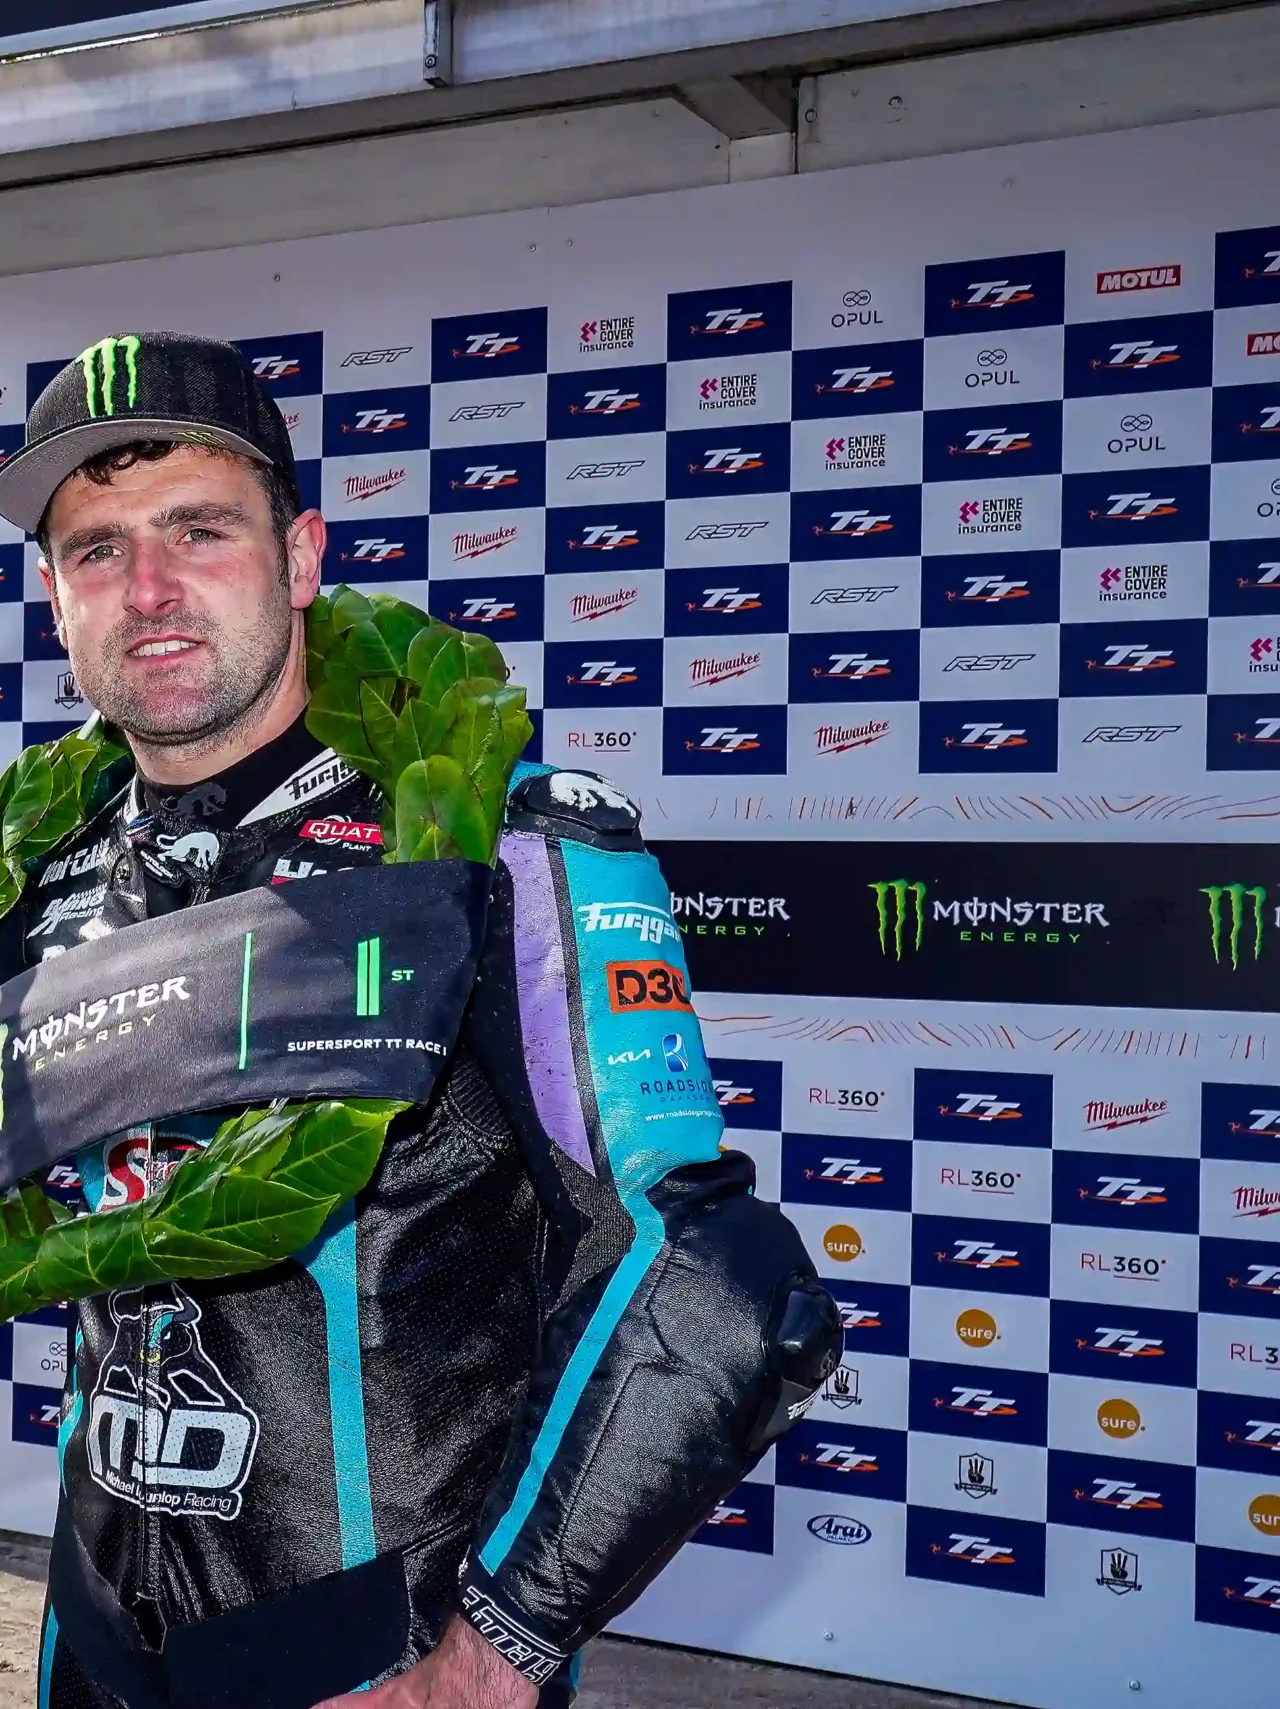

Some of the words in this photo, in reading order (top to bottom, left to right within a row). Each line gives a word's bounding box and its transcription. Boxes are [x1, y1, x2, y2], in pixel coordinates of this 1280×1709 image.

[1101, 268, 1179, 289] MOTUL
[599, 317, 634, 331] ENTIRE
[831, 310, 883, 327] OPUL
[601, 329, 634, 340] COVER
[579, 339, 634, 352] insurance
[340, 347, 413, 367] RST
[720, 374, 757, 388] ENTIRE
[965, 370, 1020, 387] OPUL
[720, 386, 756, 398] COVER
[699, 396, 756, 409] insurance
[448, 402, 525, 422] RST
[848, 434, 886, 448] ENTIRE
[1108, 436, 1166, 453] OPUL
[848, 446, 885, 459] COVER
[566, 460, 646, 480] RST
[825, 458, 886, 470] insurance
[344, 468, 406, 496] Milwaukee
[982, 498, 1023, 511] ENTIRE
[983, 510, 1022, 523] COVER
[685, 521, 769, 540] RST
[958, 522, 1022, 534] insurance
[452, 526, 518, 556] Milwaukee
[1125, 565, 1168, 579] ENTIRE
[1125, 577, 1167, 590] COVER
[570, 588, 638, 616] Milwaukee
[810, 586, 899, 604] RST
[1099, 590, 1168, 601] insurance
[688, 653, 761, 679] Milwaukee
[942, 654, 1036, 672] RST
[814, 721, 890, 748] Milwaukee
[1081, 725, 1183, 743] RST
[342, 842, 372, 851] PLANT
[670, 891, 790, 920] ONSTER
[933, 896, 1109, 928] MONSTER
[678, 925, 765, 936] NERGY
[960, 931, 1081, 943] ENERGY
[391, 970, 414, 981] ST
[11, 975, 190, 1062] MONSTER
[33, 1015, 154, 1071] ENERGY
[287, 1039, 382, 1052] SUPERSPORT
[385, 1039, 402, 1049] TT
[406, 1039, 440, 1054] RACE
[640, 1079, 714, 1096] ROADSID
[1083, 1098, 1168, 1124] Milwaukee
[105, 1469, 134, 1495] Michael
[183, 1493, 231, 1512] Racing
